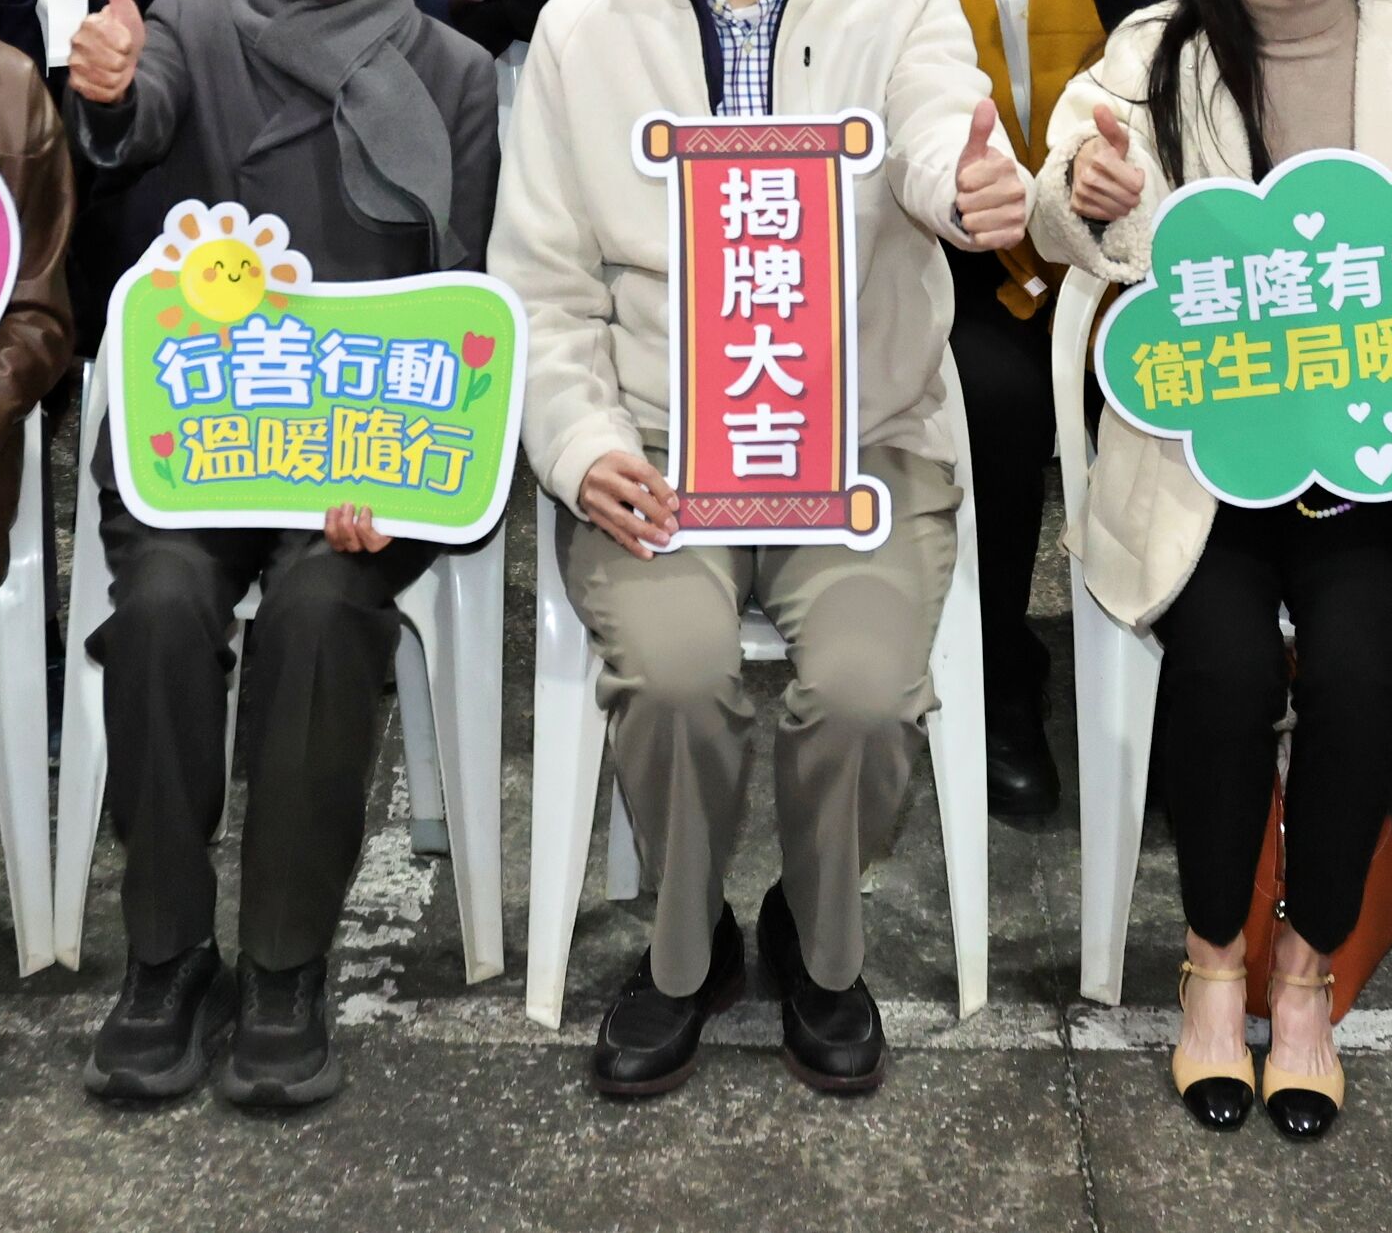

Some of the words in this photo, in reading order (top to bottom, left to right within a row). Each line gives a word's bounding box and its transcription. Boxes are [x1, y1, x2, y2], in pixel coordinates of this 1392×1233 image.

[158, 315, 458, 410] 行善行動
[719, 166, 804, 480] 揭牌大吉
[181, 407, 474, 492] 溫暖隨行
